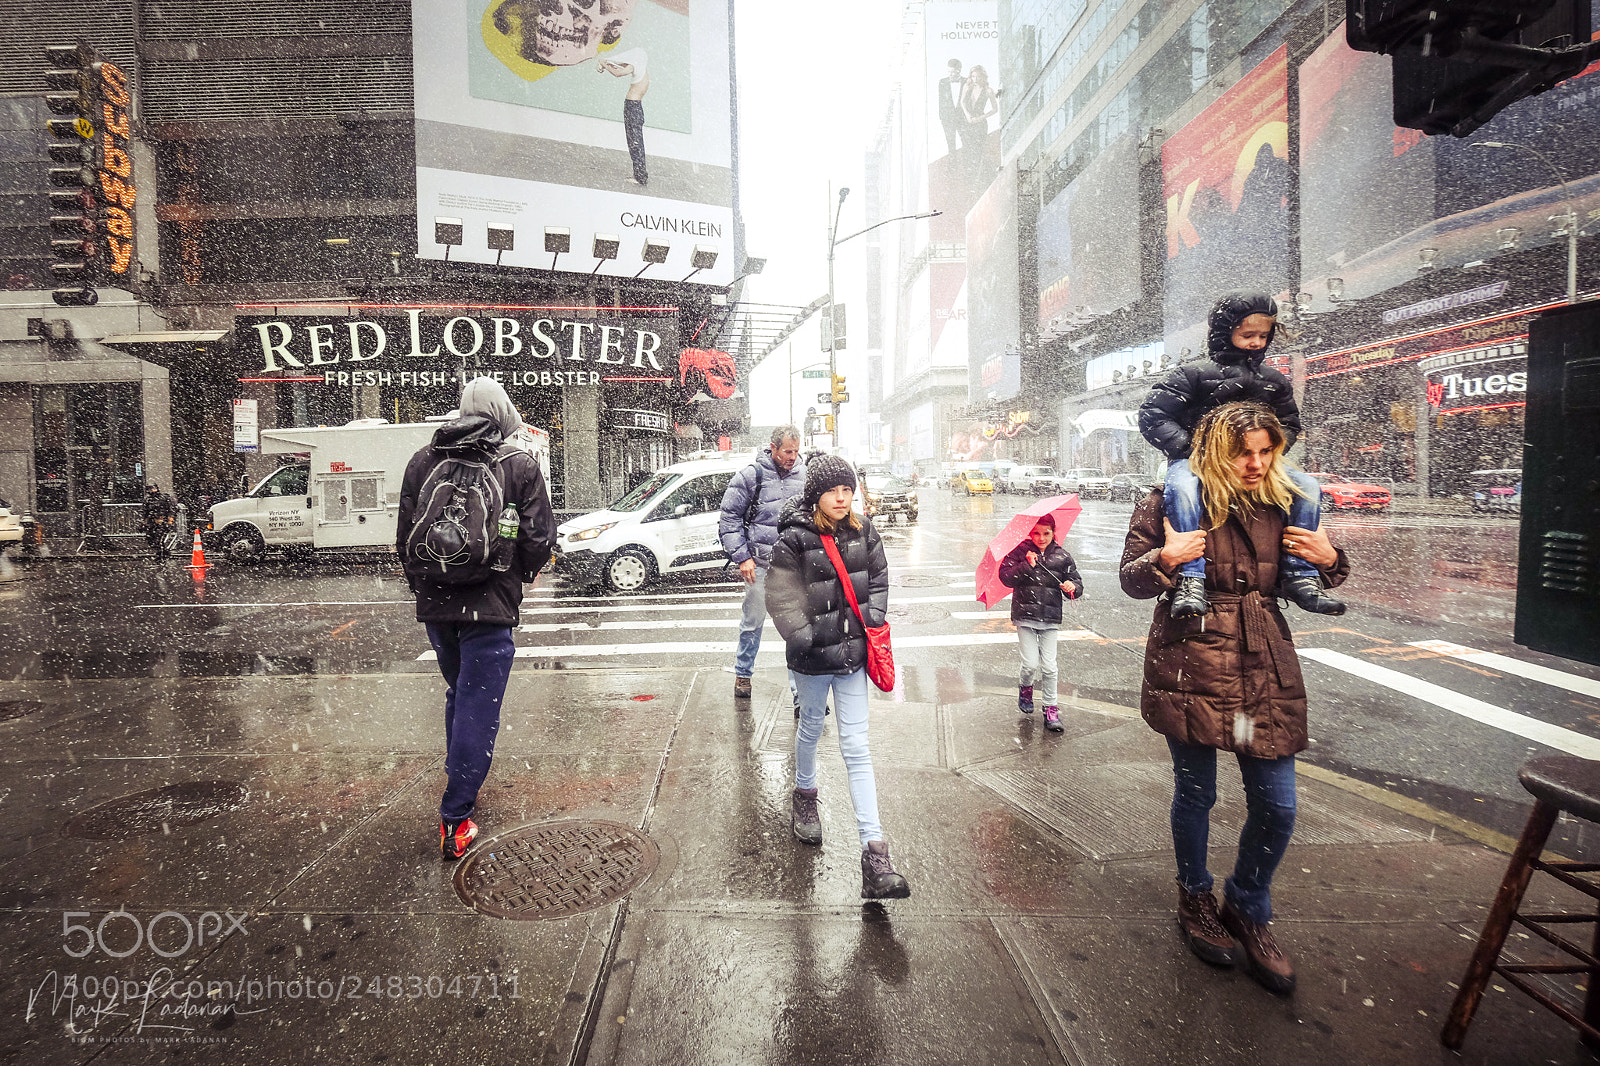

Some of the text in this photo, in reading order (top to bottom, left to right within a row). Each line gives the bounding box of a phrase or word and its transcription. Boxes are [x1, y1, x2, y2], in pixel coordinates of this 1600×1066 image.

[941, 31, 999, 40] HOLLYWOO
[956, 20, 999, 30] NEVER T
[620, 211, 722, 239] CALVIN KLEIN
[251, 308, 664, 373] RED LOBSTER
[325, 371, 391, 387] FRESH
[401, 371, 446, 387] FISH
[513, 371, 601, 387] LOBSTER
[1443, 372, 1528, 399] Tues
